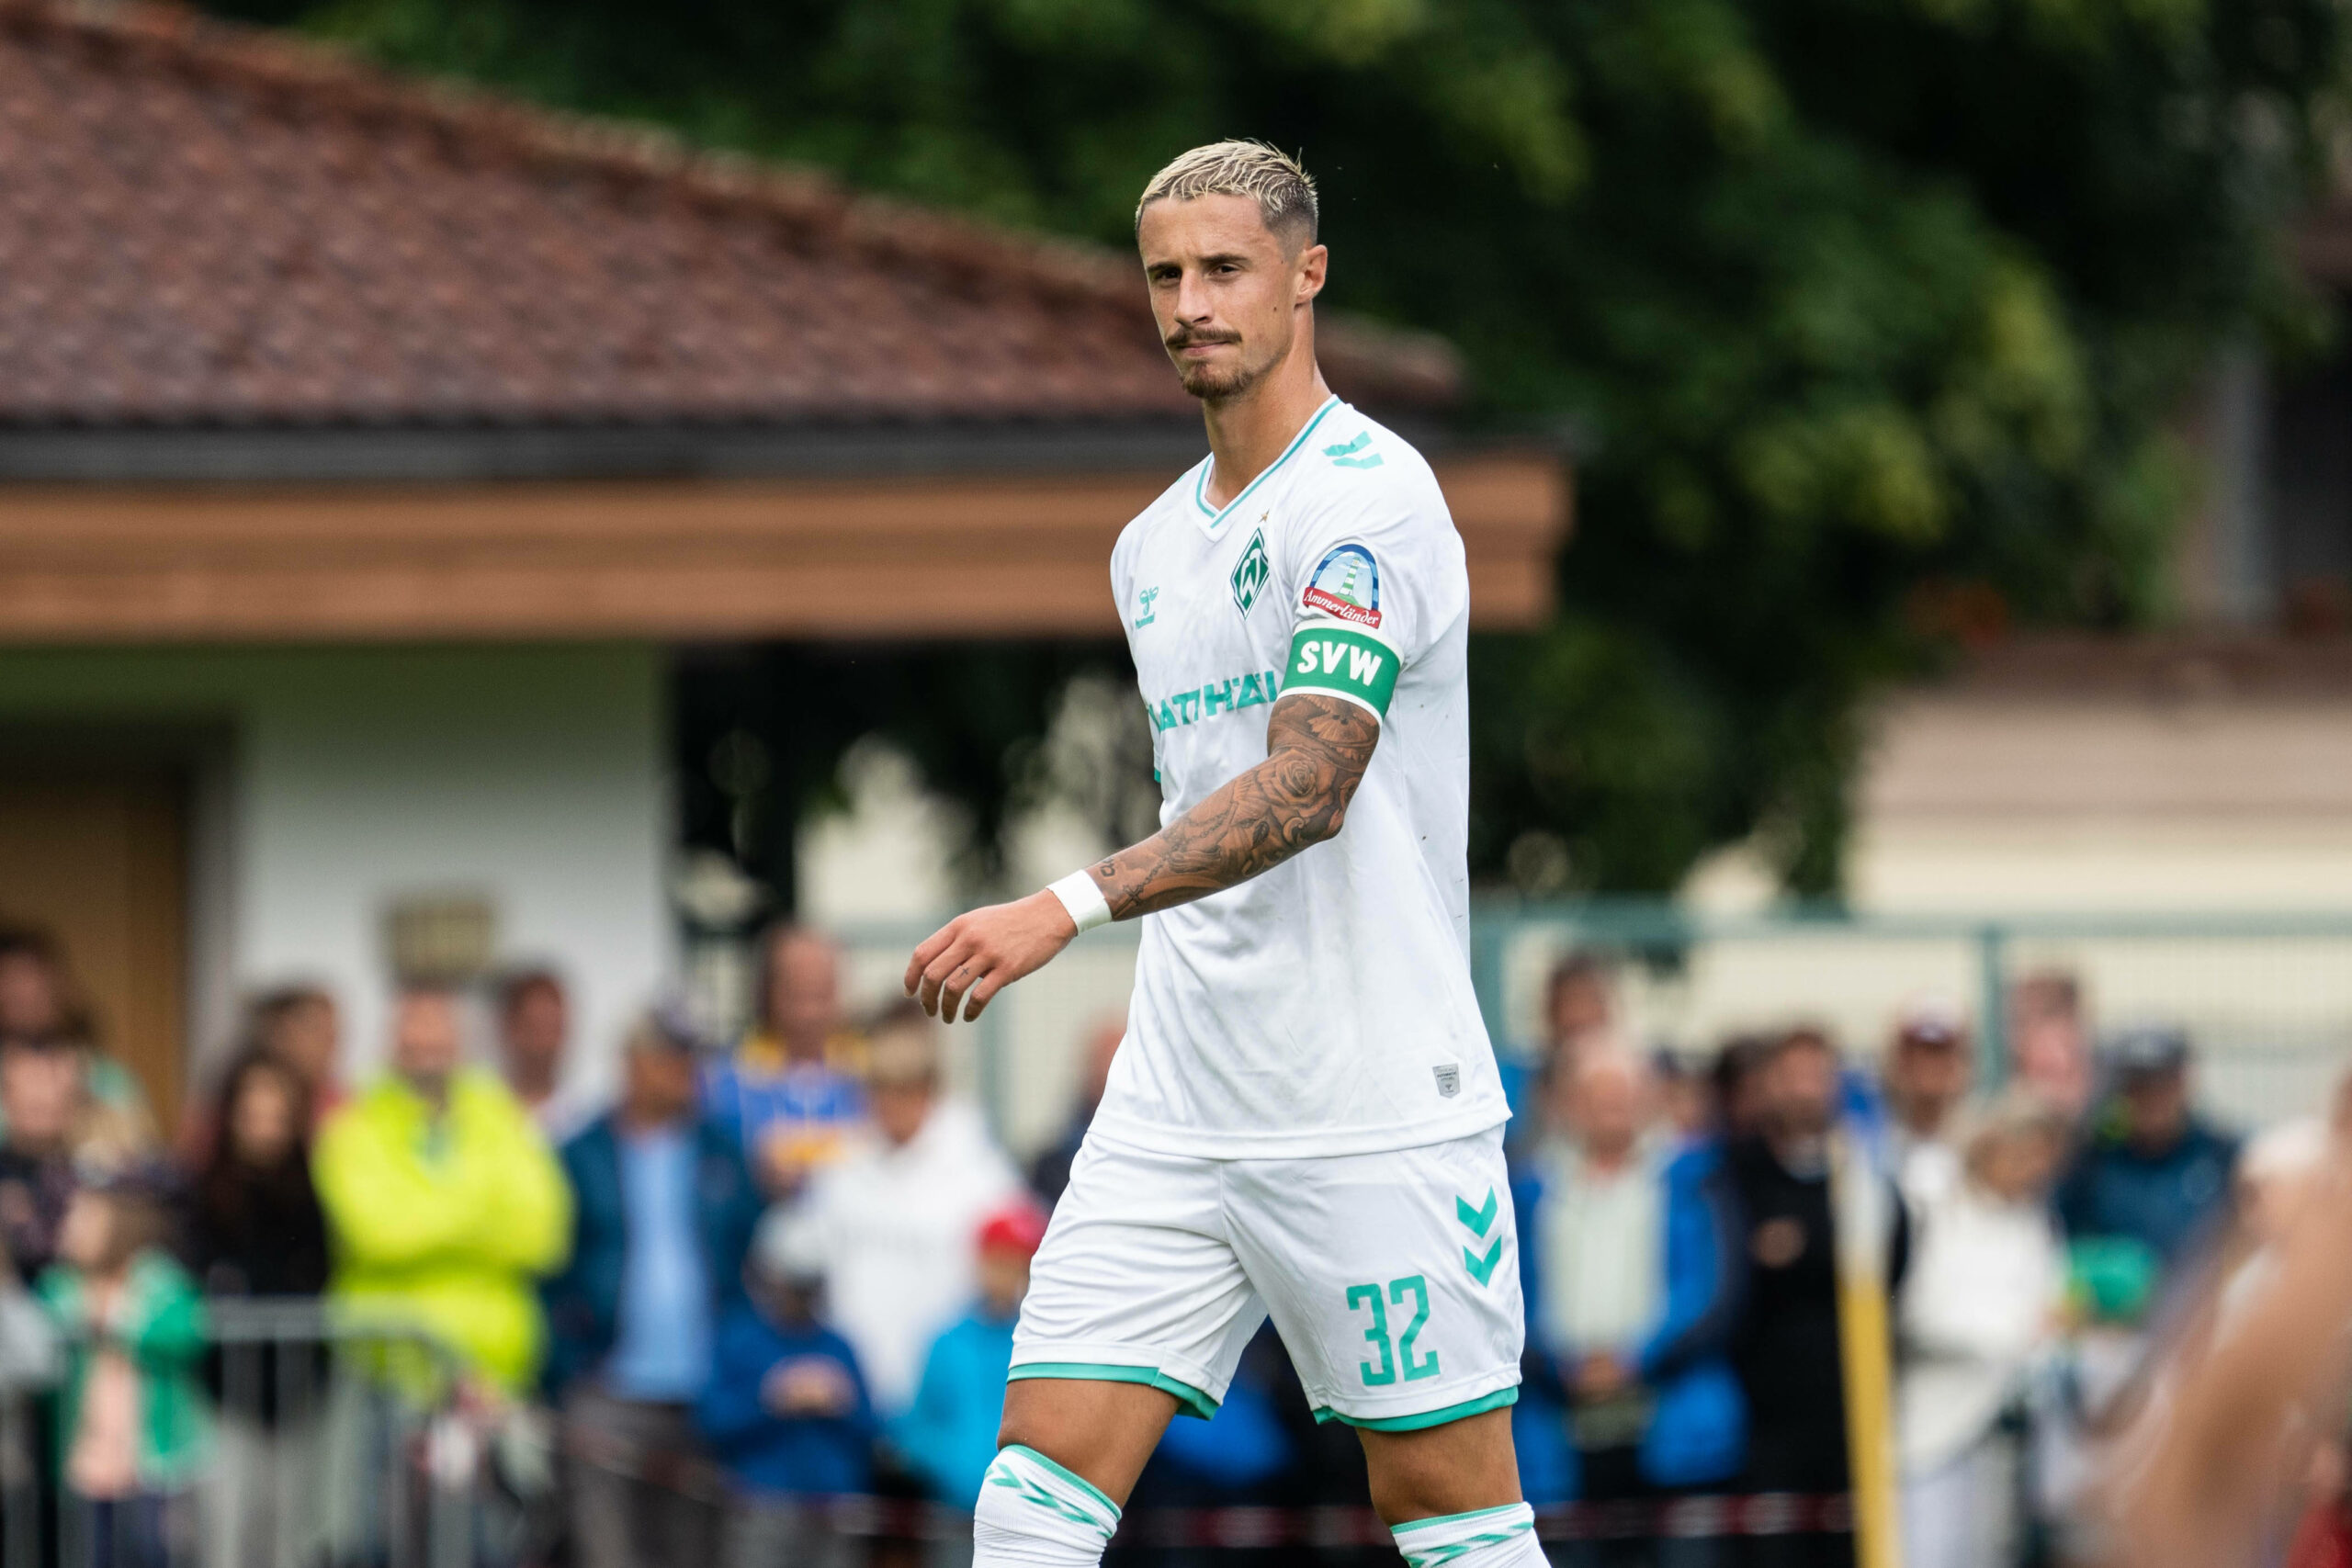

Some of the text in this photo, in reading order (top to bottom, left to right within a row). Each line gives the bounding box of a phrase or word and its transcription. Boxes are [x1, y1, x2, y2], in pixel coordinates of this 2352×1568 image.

[1304, 590, 1378, 625] Ammerländer
[1297, 640, 1382, 686] SVW
[1346, 1275, 1441, 1386] 32
